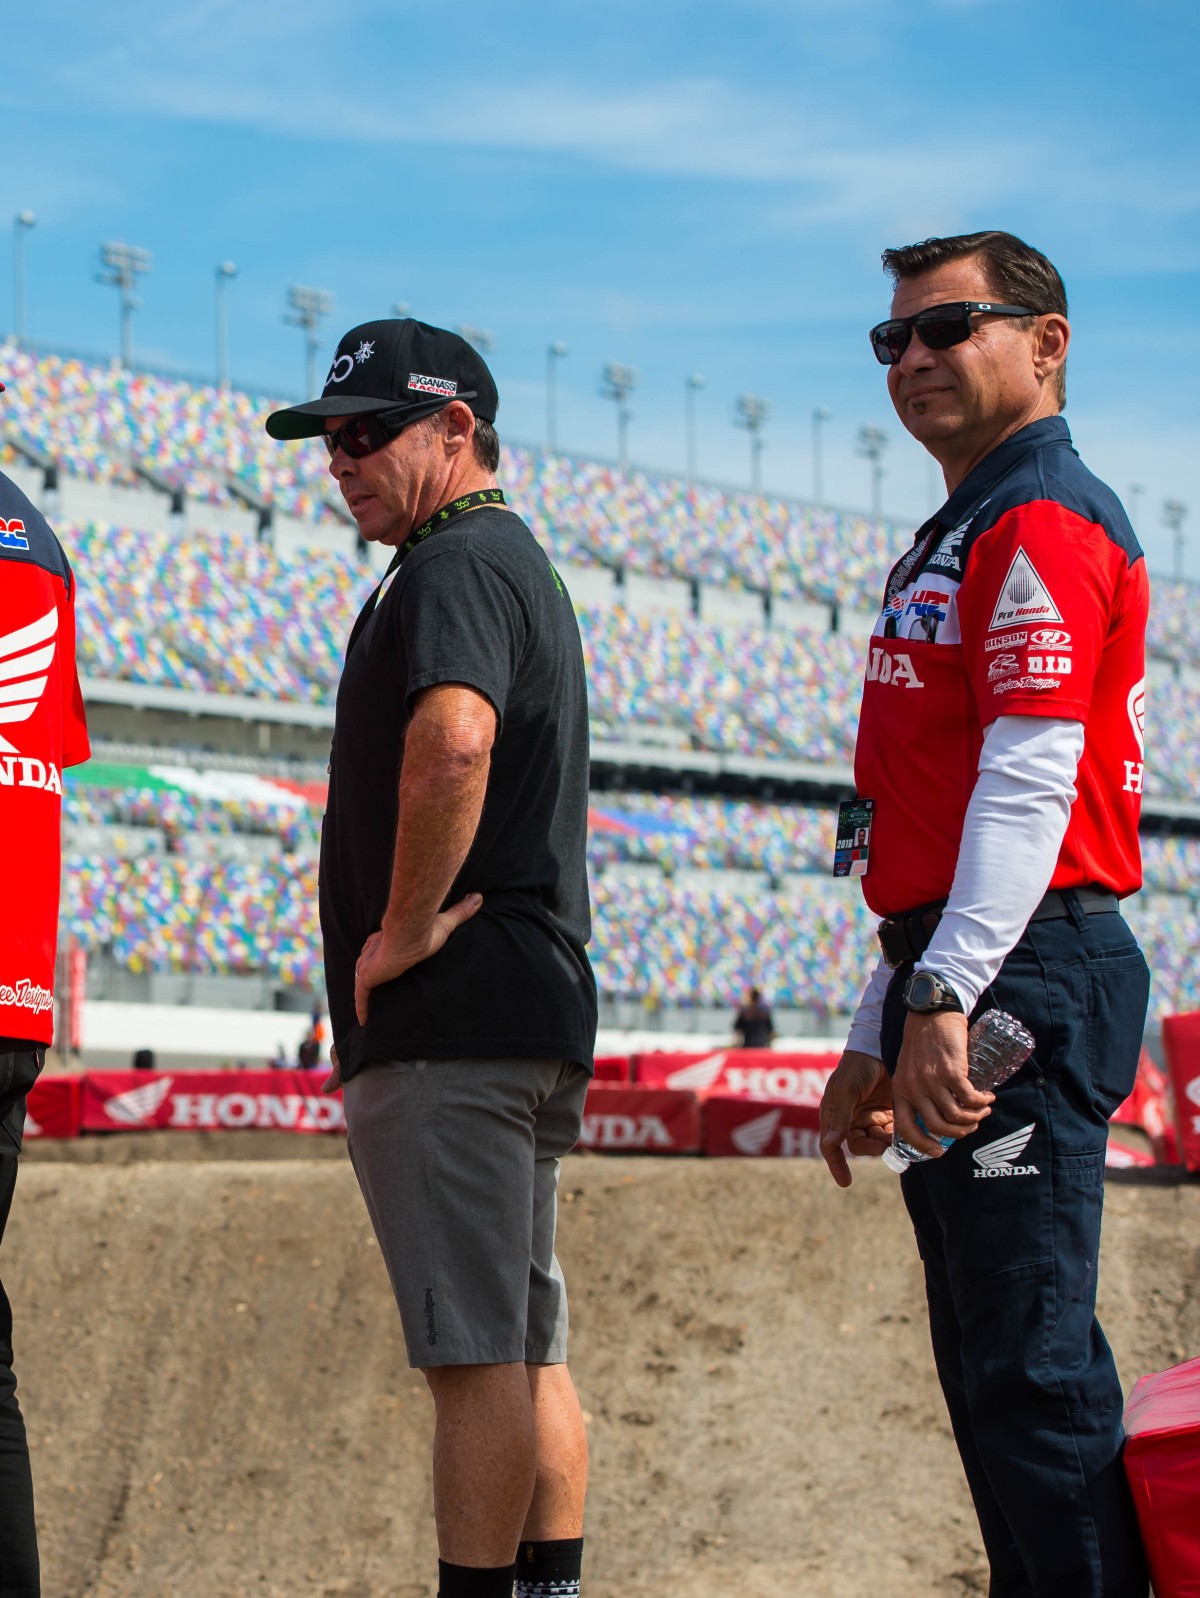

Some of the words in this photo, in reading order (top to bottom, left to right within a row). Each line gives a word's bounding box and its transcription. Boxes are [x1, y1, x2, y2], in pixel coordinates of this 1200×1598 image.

[420, 376, 457, 391] GANASSI
[927, 554, 961, 572] ONA
[997, 611, 1014, 621] Pro
[1015, 605, 1050, 617] Honda
[985, 631, 1028, 648] HINSON
[866, 648, 924, 688] NDA
[1028, 656, 1072, 674] D.I.D
[837, 839, 853, 849] 2016
[726, 1067, 835, 1105] HON
[169, 1093, 347, 1130] HOND
[580, 1114, 677, 1147] NDA
[973, 1165, 1040, 1178] HONDA
